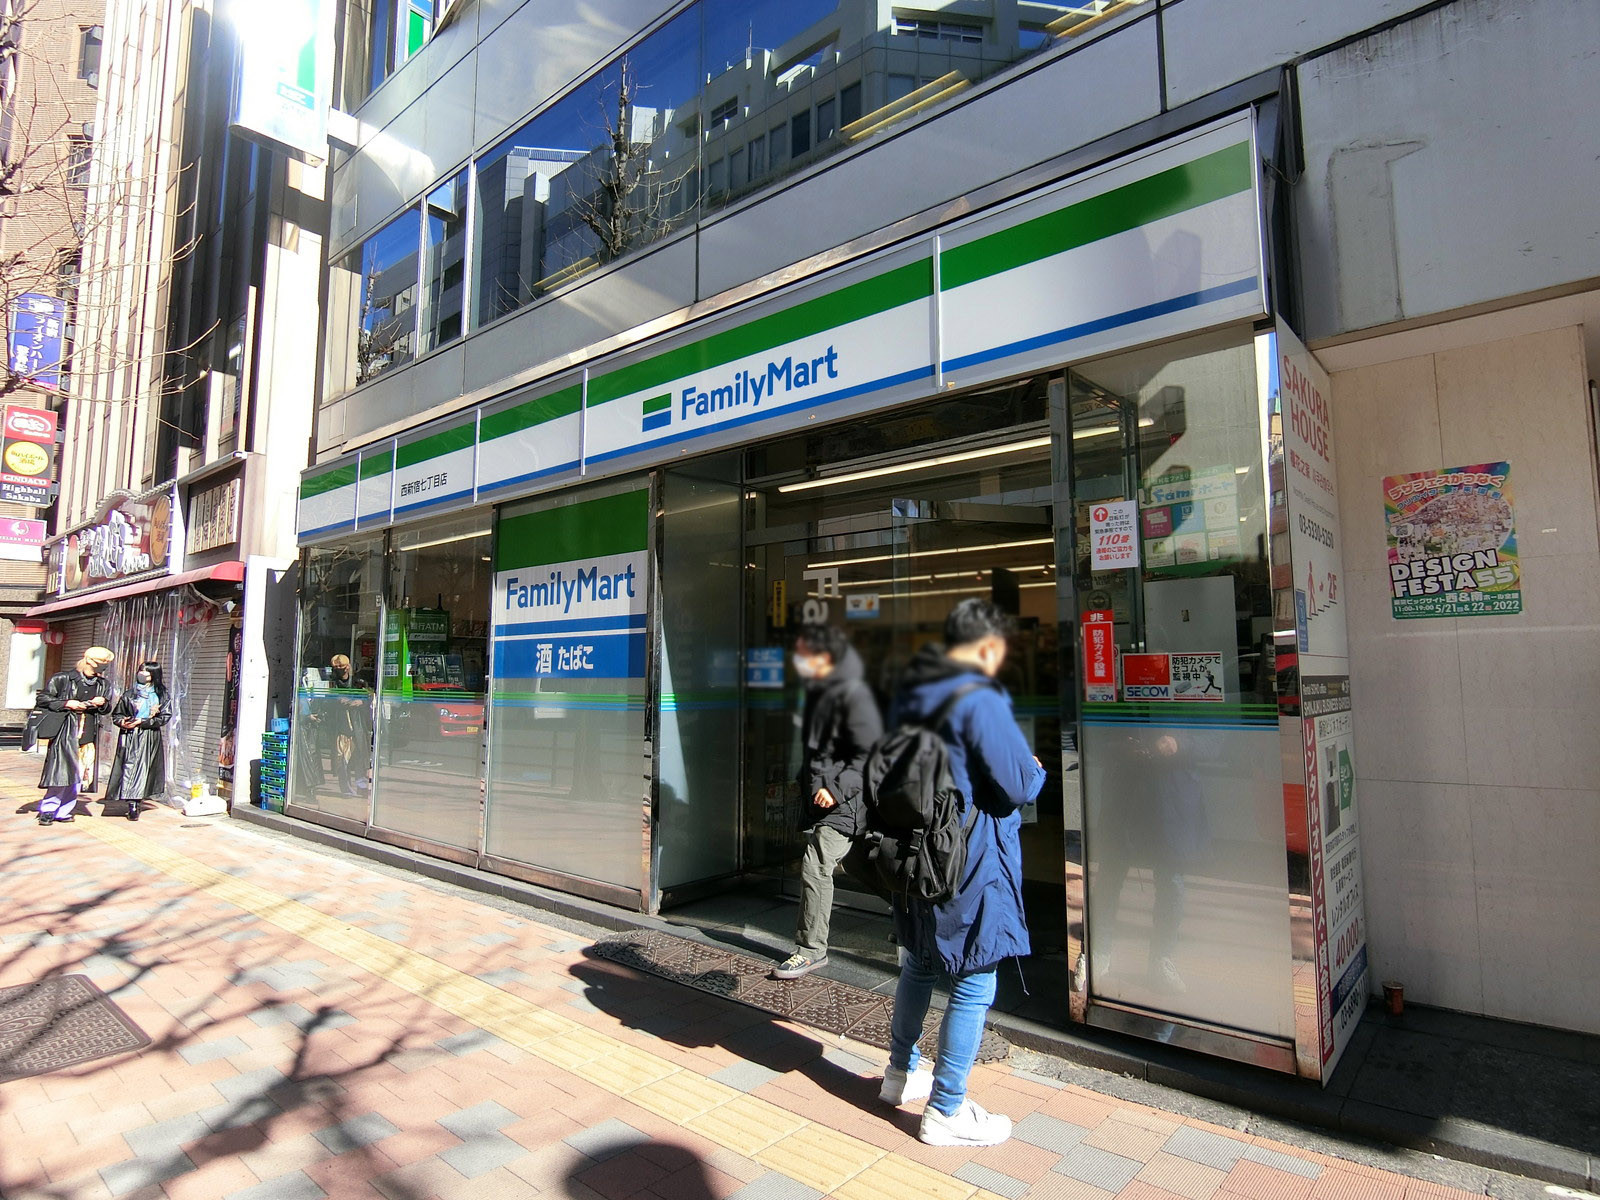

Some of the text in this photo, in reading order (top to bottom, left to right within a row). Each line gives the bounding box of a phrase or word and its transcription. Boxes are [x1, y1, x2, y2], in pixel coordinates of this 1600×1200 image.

[681, 345, 838, 421] FamilyMart
[1283, 354, 1331, 432] SAKURA
[1290, 397, 1330, 464] HOUSE
[2, 483, 46, 496] Highball
[401, 472, 448, 497] 西新宿七丁目店
[5, 492, 41, 503] Sakaba
[1099, 533, 1130, 546] 110番
[1390, 548, 1499, 582] DESIGN
[506, 563, 636, 614] FamilyMart
[1327, 571, 1338, 600] 2F
[1393, 566, 1515, 599] FESTA 55
[1435, 603, 1457, 613] 5/21
[1472, 602, 1485, 611] 22
[1493, 600, 1520, 611] 2022
[535, 643, 594, 674] 酒 たばこ
[1092, 629, 1106, 677] 防犯カメラ設置
[1171, 655, 1221, 666] 防犯カメラで
[1172, 664, 1208, 674] セコムが
[1172, 673, 1201, 681] 監視中
[1088, 693, 1115, 701] SECOM
[1126, 686, 1170, 698] SECOM
